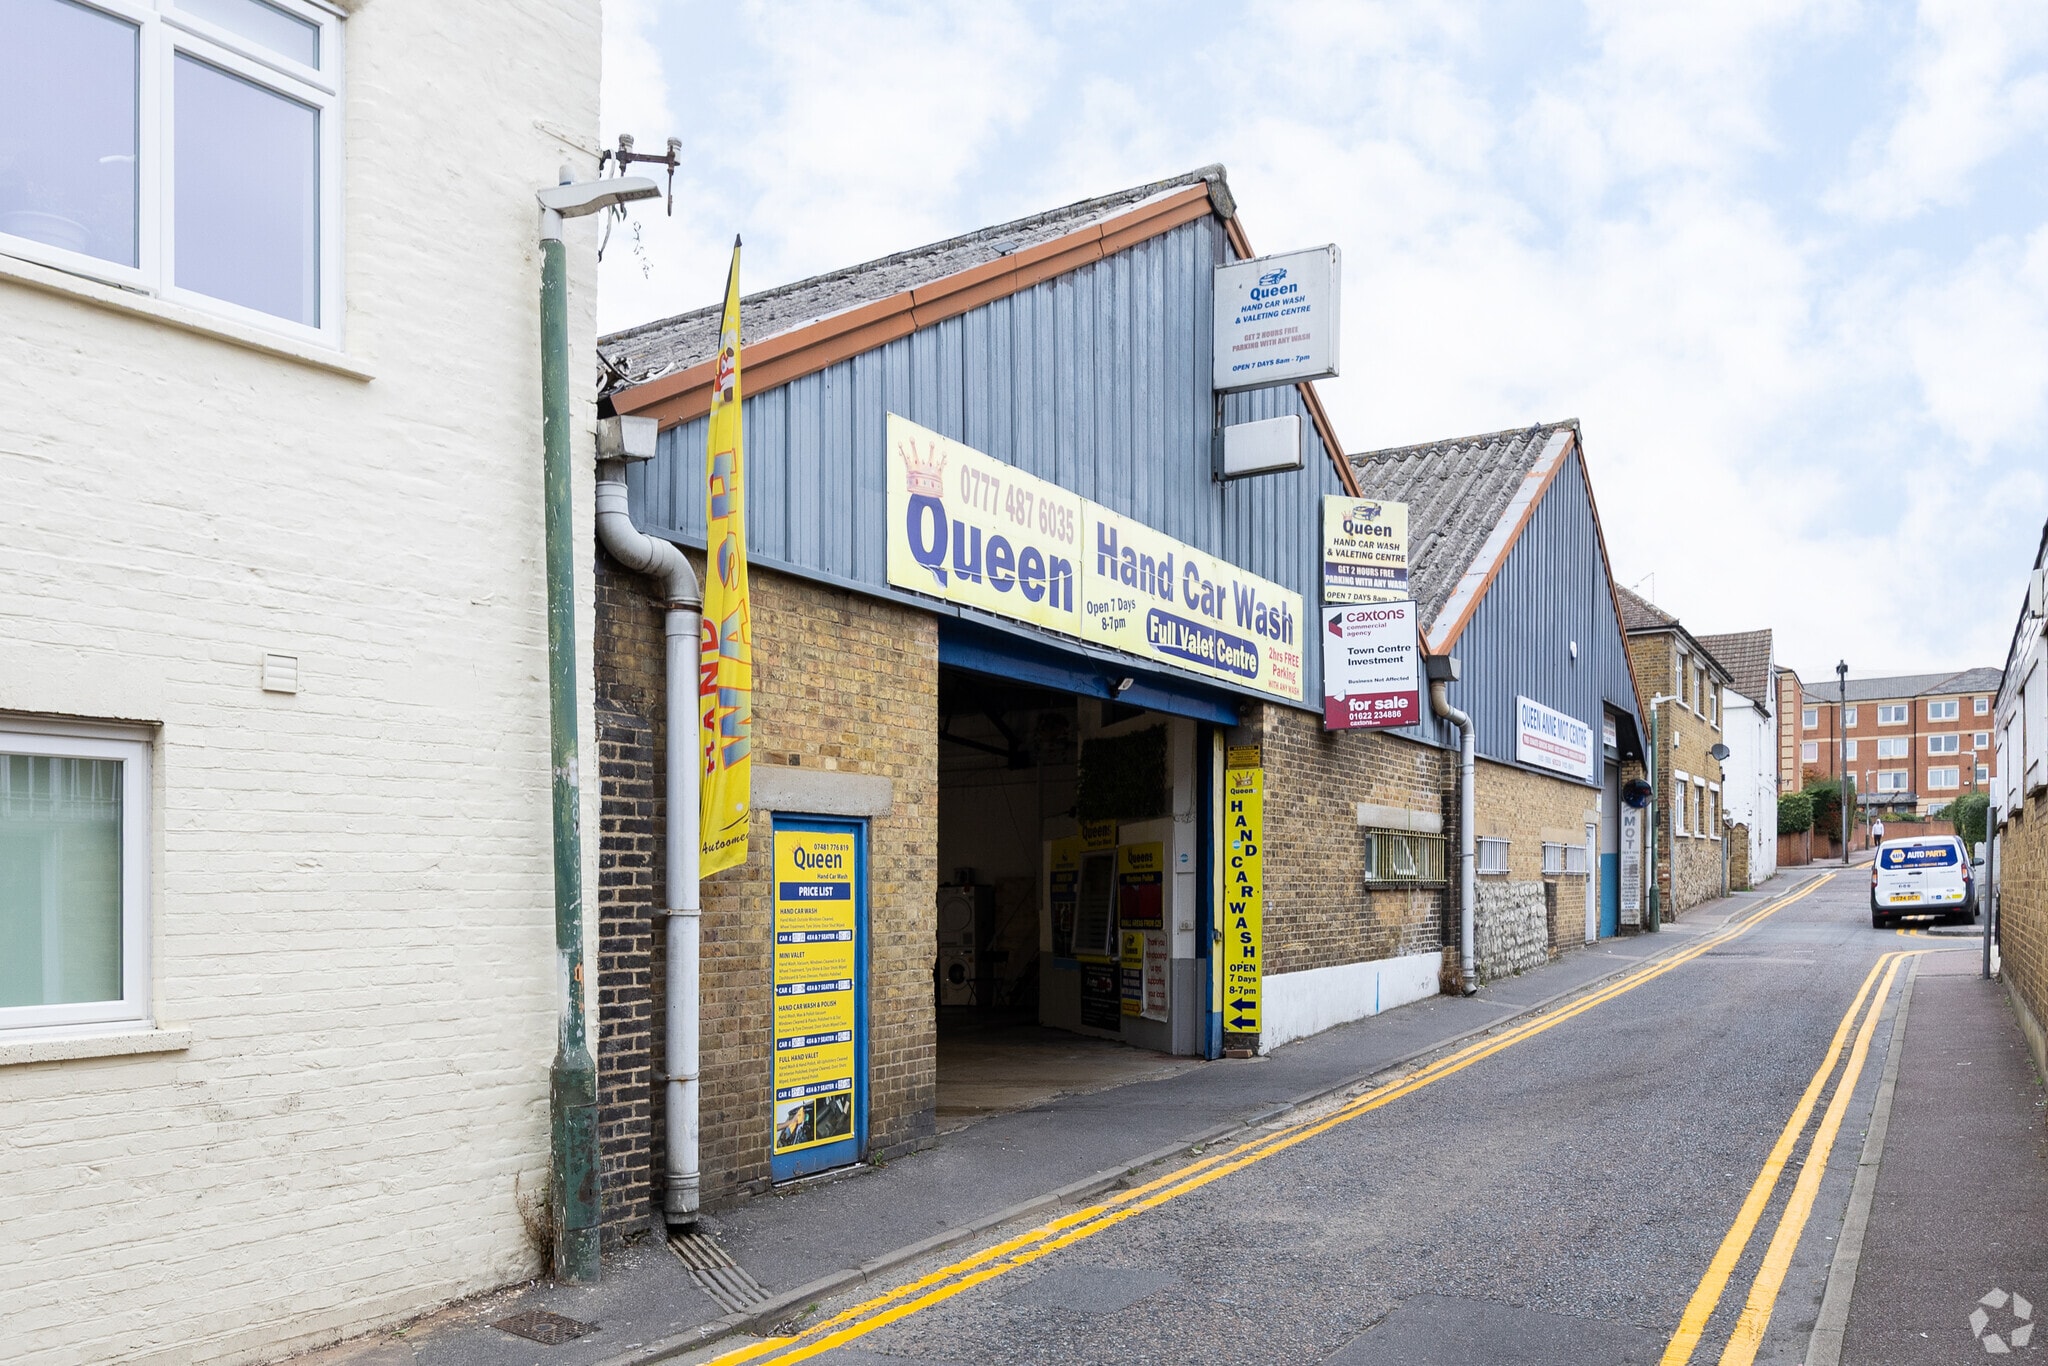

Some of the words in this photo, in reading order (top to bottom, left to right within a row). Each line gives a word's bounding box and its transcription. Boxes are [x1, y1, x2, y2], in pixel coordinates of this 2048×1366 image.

[1250, 283, 1298, 301] Queen
[1241, 303, 1263, 313] HAND
[1265, 300, 1280, 309] CAR
[1282, 295, 1306, 305] WASH
[1243, 311, 1279, 323] VALETING
[1281, 305, 1311, 316] CENTRE
[1244, 333, 1256, 342] GET
[1262, 329, 1283, 339] HOURS
[1284, 326, 1299, 334] FREE
[1232, 341, 1259, 352] PARKING
[1260, 338, 1277, 348] WITH
[1278, 337, 1290, 345] ANY
[1291, 333, 1311, 343] WASH
[1257, 360, 1274, 368] DAYS
[1296, 354, 1310, 362] 7pm
[960, 464, 1000, 516] 0777
[1005, 484, 1034, 529] 487
[1039, 497, 1074, 545] 6035
[1343, 520, 1392, 537] Queen
[1333, 538, 1356, 547] HAND
[1358, 540, 1375, 549] CAR
[1377, 542, 1400, 551] WASH
[906, 493, 1073, 613] Queen
[1327, 548, 1333, 556] &
[1336, 550, 1373, 560] VALETING
[1375, 553, 1406, 563] CENTRE
[1338, 565, 1350, 575] GET
[1351, 566, 1355, 575] 2
[1357, 567, 1379, 577] HOURS
[1380, 569, 1394, 578] FREE
[1097, 521, 1174, 603] Hand
[1182, 560, 1226, 620] Car
[1233, 580, 1294, 645] Wash
[1326, 575, 1354, 586] PARKING
[1355, 577, 1373, 587] WITH
[1373, 579, 1387, 588] ANY
[1387, 580, 1407, 589] WASH
[1354, 593, 1371, 601] DAYS
[1087, 600, 1110, 617] Open
[1111, 599, 1115, 611] 7
[1118, 598, 1136, 612] Days
[1101, 616, 1126, 632] 8-7pm
[1346, 609, 1405, 623] caxtons
[1347, 622, 1387, 630] commercial
[1150, 615, 1177, 646] Full
[1179, 624, 1214, 660] Valet
[1216, 638, 1257, 672] Centre
[1347, 647, 1375, 655] Town
[1377, 645, 1411, 653] Centre
[1269, 647, 1284, 663] 2hrs
[1284, 652, 1299, 668] FREE
[1348, 655, 1404, 666] Investment
[1272, 664, 1296, 684] Parking
[1268, 680, 1279, 690] WITH
[1349, 698, 1371, 711] for
[1375, 696, 1408, 710] sale
[1349, 712, 1372, 720] 01622
[1522, 704, 1542, 731] QUEEN
[1542, 712, 1556, 737] ANNE
[1569, 723, 1587, 749] CENTRE
[1231, 800, 1257, 857] HAND
[1624, 816, 1635, 849] MOT
[794, 846, 842, 871] Queen
[1907, 851, 1925, 859] AUTO
[1925, 849, 1947, 858] PARTS
[1231, 856, 1254, 898] CAR
[798, 886, 819, 897] PRICE
[819, 886, 834, 897] LIST
[1229, 902, 1256, 958] WASH
[1229, 963, 1256, 973] OPEN
[1229, 974, 1235, 983] 7
[1237, 975, 1257, 984] Days
[1229, 986, 1257, 996] 8-7pm
